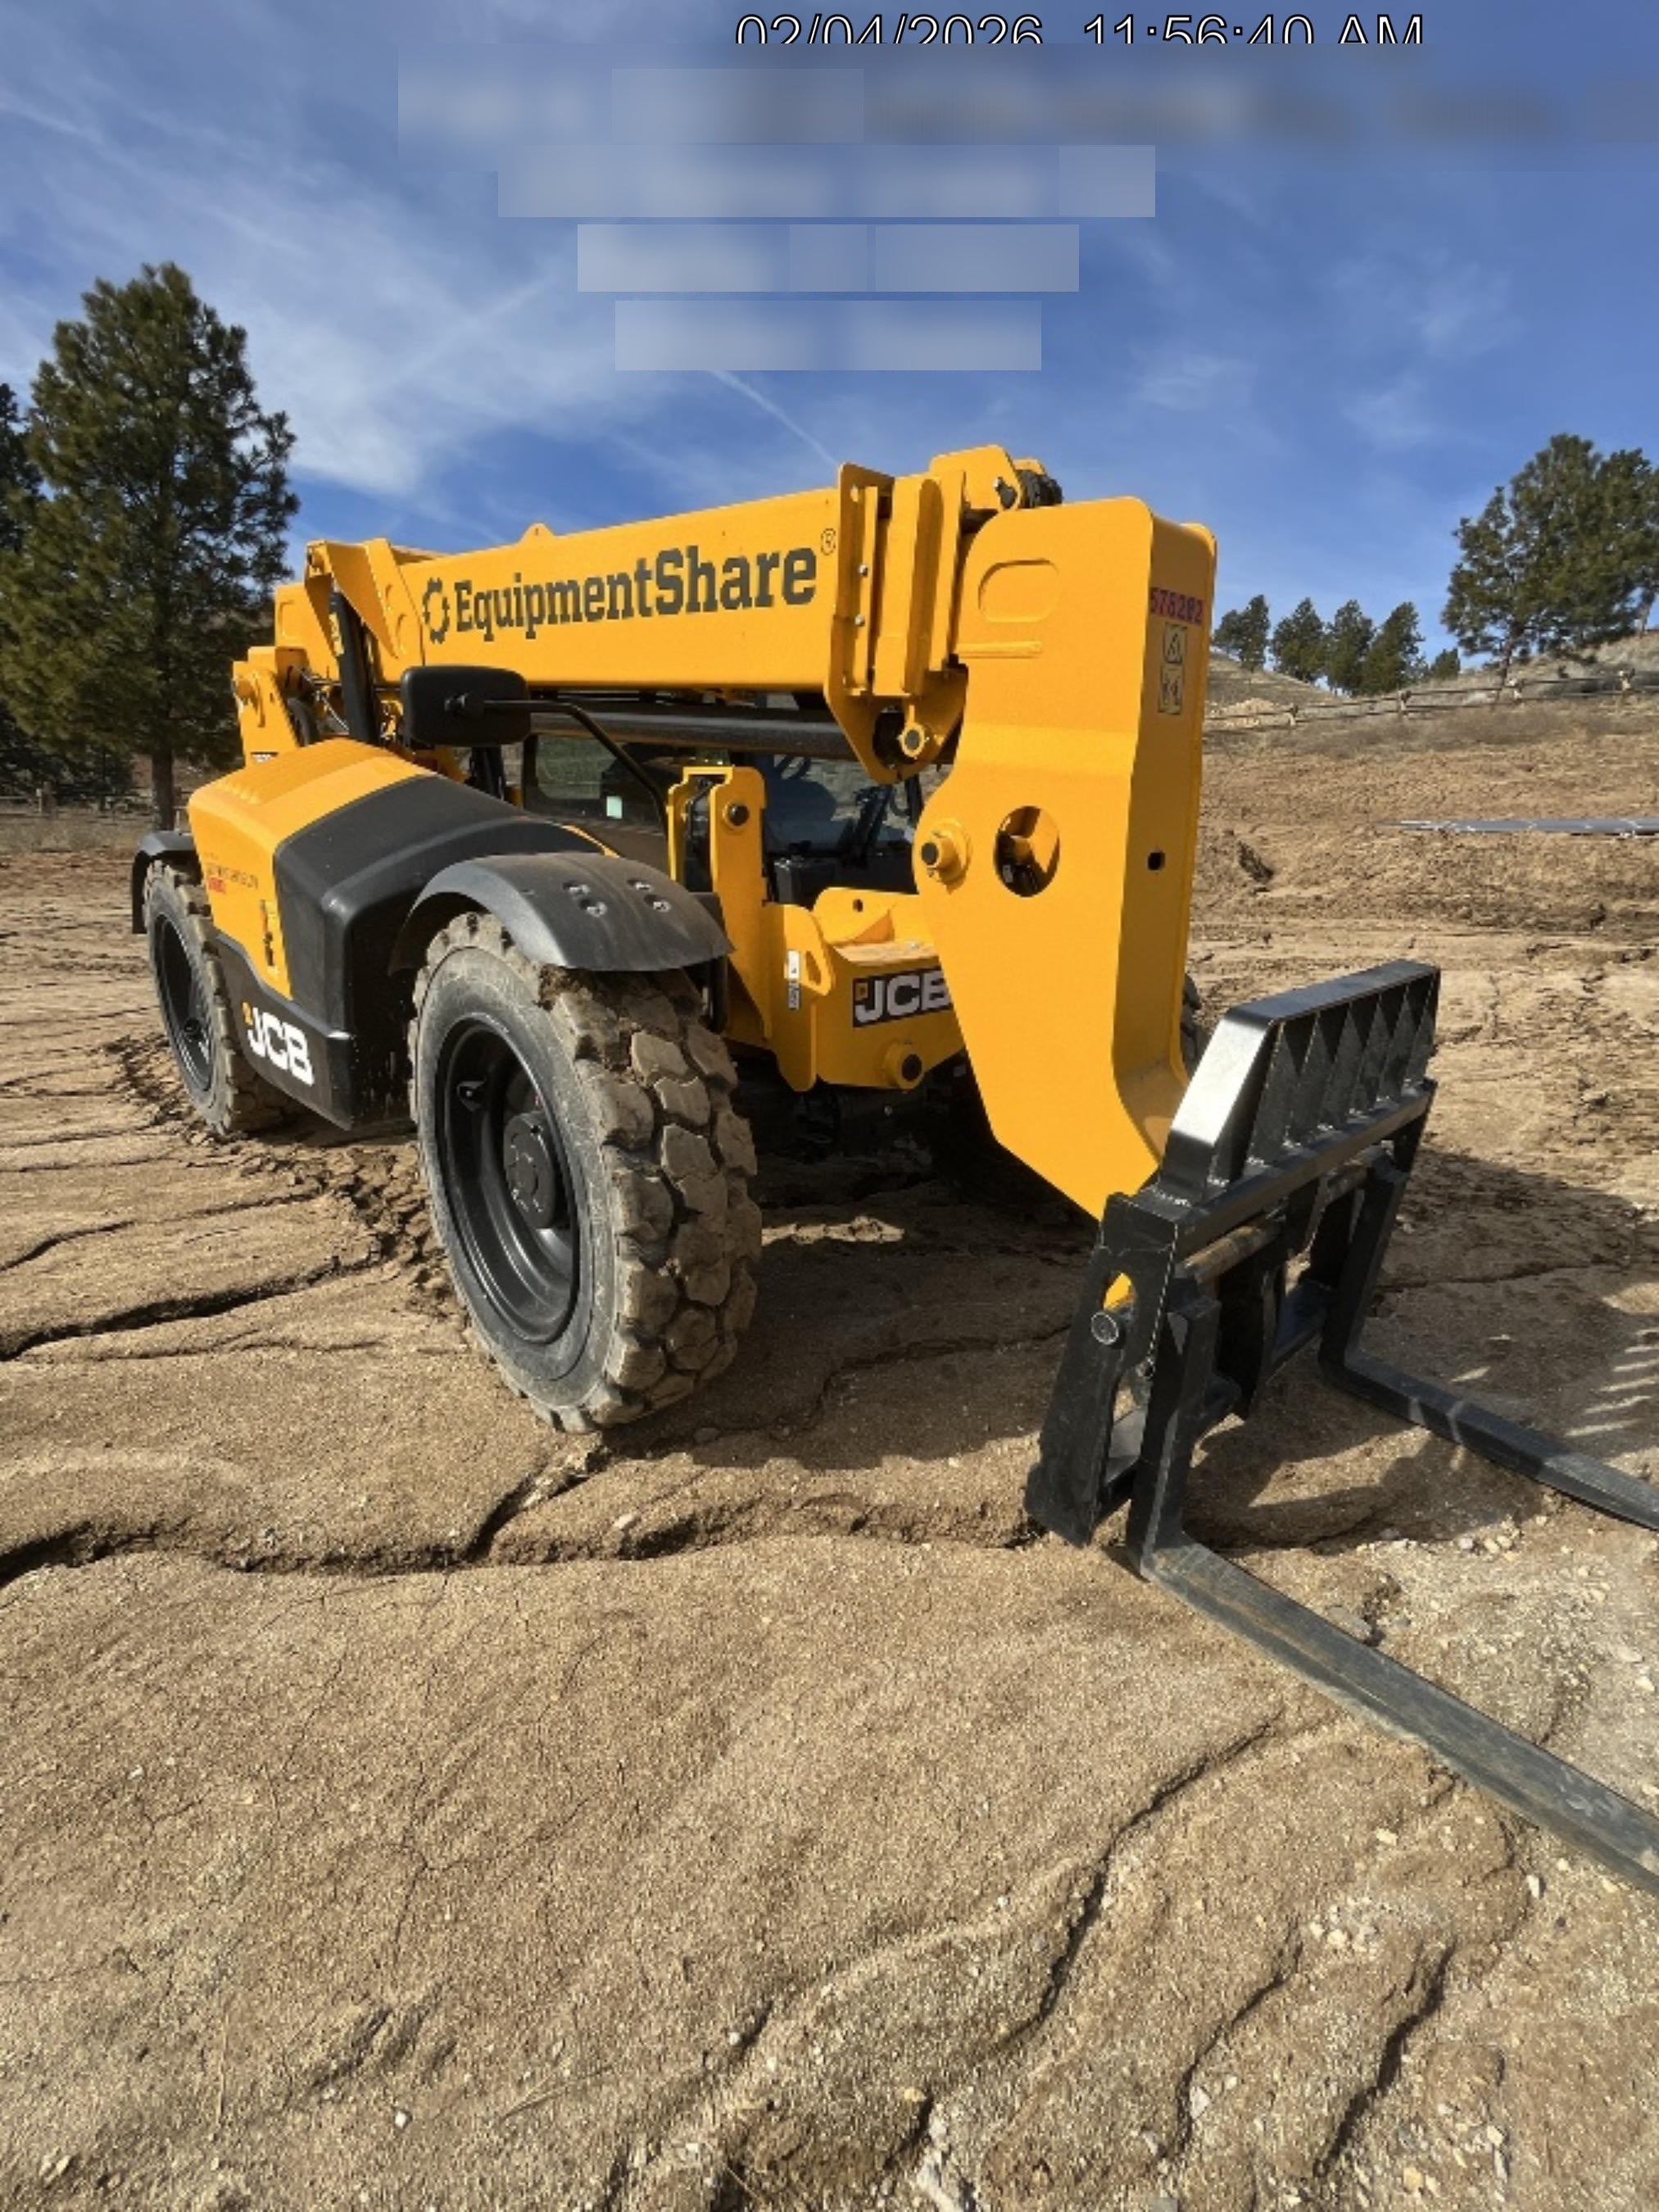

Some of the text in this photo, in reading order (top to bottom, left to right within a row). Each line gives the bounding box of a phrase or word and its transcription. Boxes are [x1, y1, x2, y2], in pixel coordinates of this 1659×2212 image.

[454, 545, 818, 642] EquipmentShare
[854, 970, 953, 1023] JCB
[243, 1004, 315, 1087] JCB
